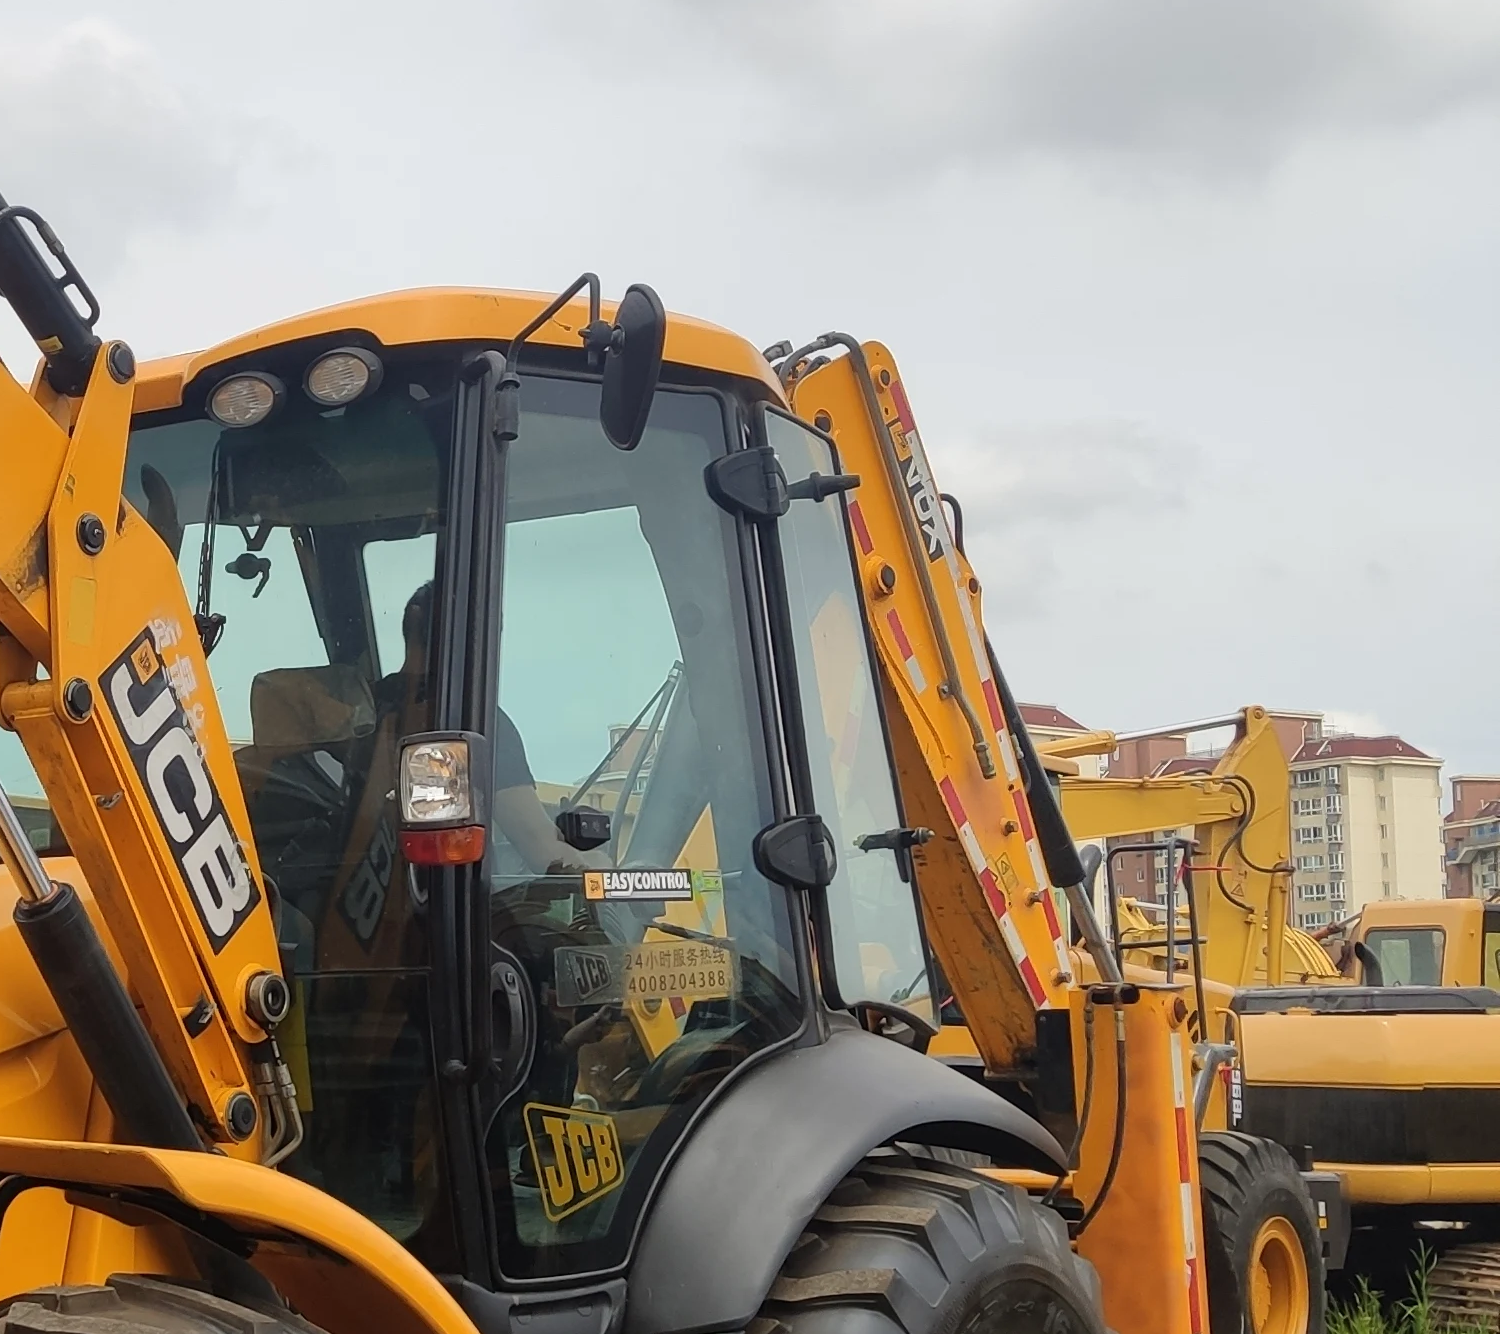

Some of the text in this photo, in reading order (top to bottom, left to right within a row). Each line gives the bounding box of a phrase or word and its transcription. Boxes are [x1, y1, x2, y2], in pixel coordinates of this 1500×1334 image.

[110, 663, 251, 937] JCB
[574, 954, 609, 995] JCB
[624, 946, 727, 971] 24小时服务热线
[628, 970, 726, 993] 4008204388
[542, 1115, 618, 1207] JCB
